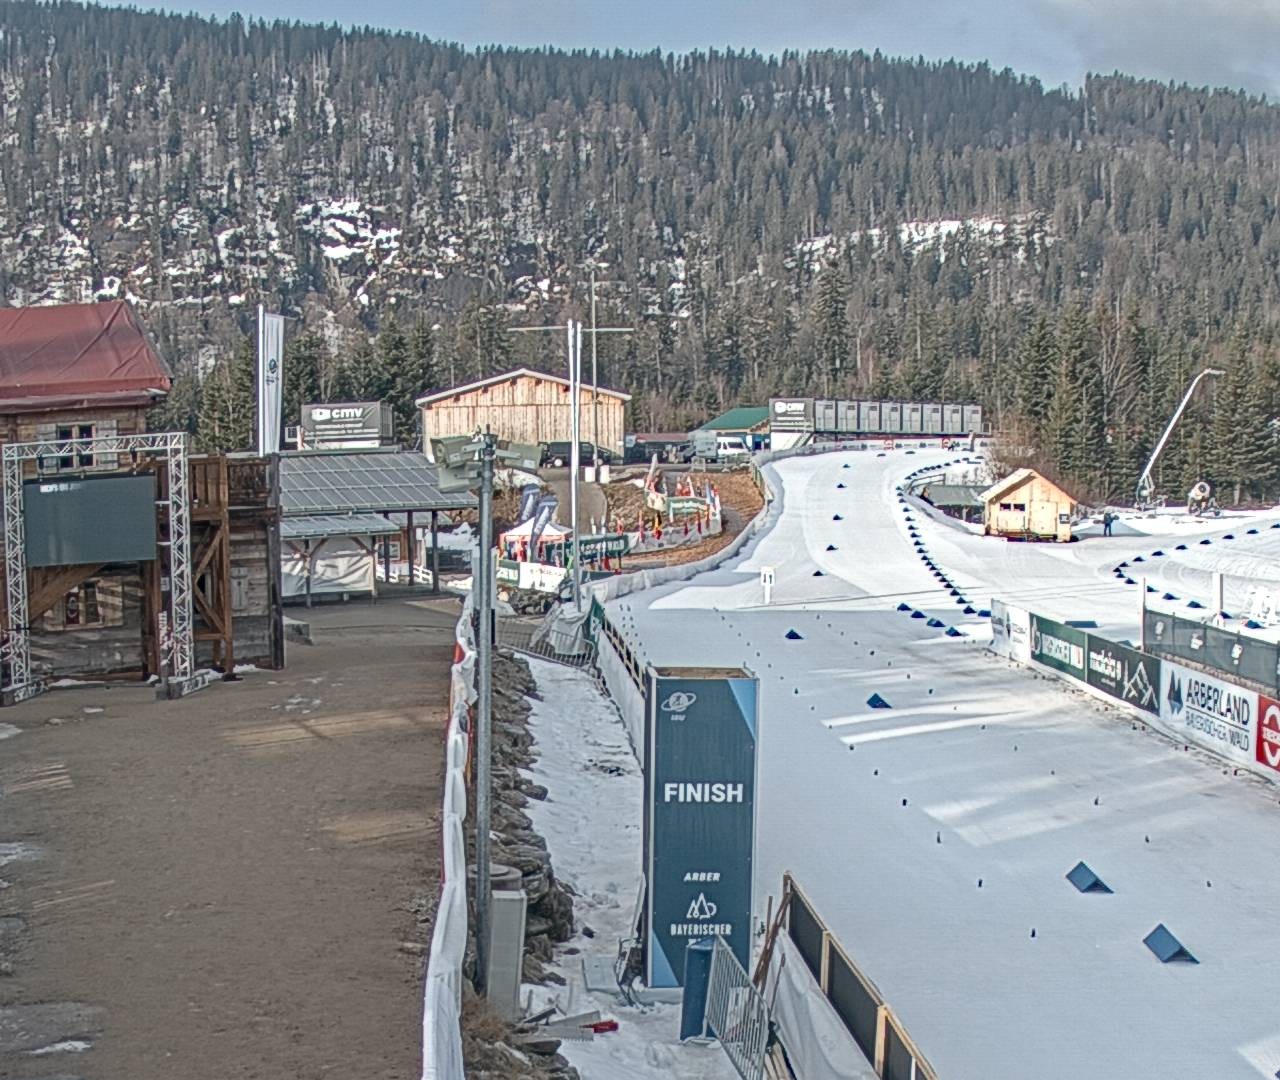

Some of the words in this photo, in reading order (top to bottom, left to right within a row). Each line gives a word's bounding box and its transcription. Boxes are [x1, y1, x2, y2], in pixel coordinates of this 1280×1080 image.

[332, 408, 363, 419] cmv
[1186, 678, 1250, 725] ARBERLAND
[664, 783, 744, 803] FINISH
[684, 872, 721, 882] ARBER
[670, 924, 732, 936] BAYERISCHER
